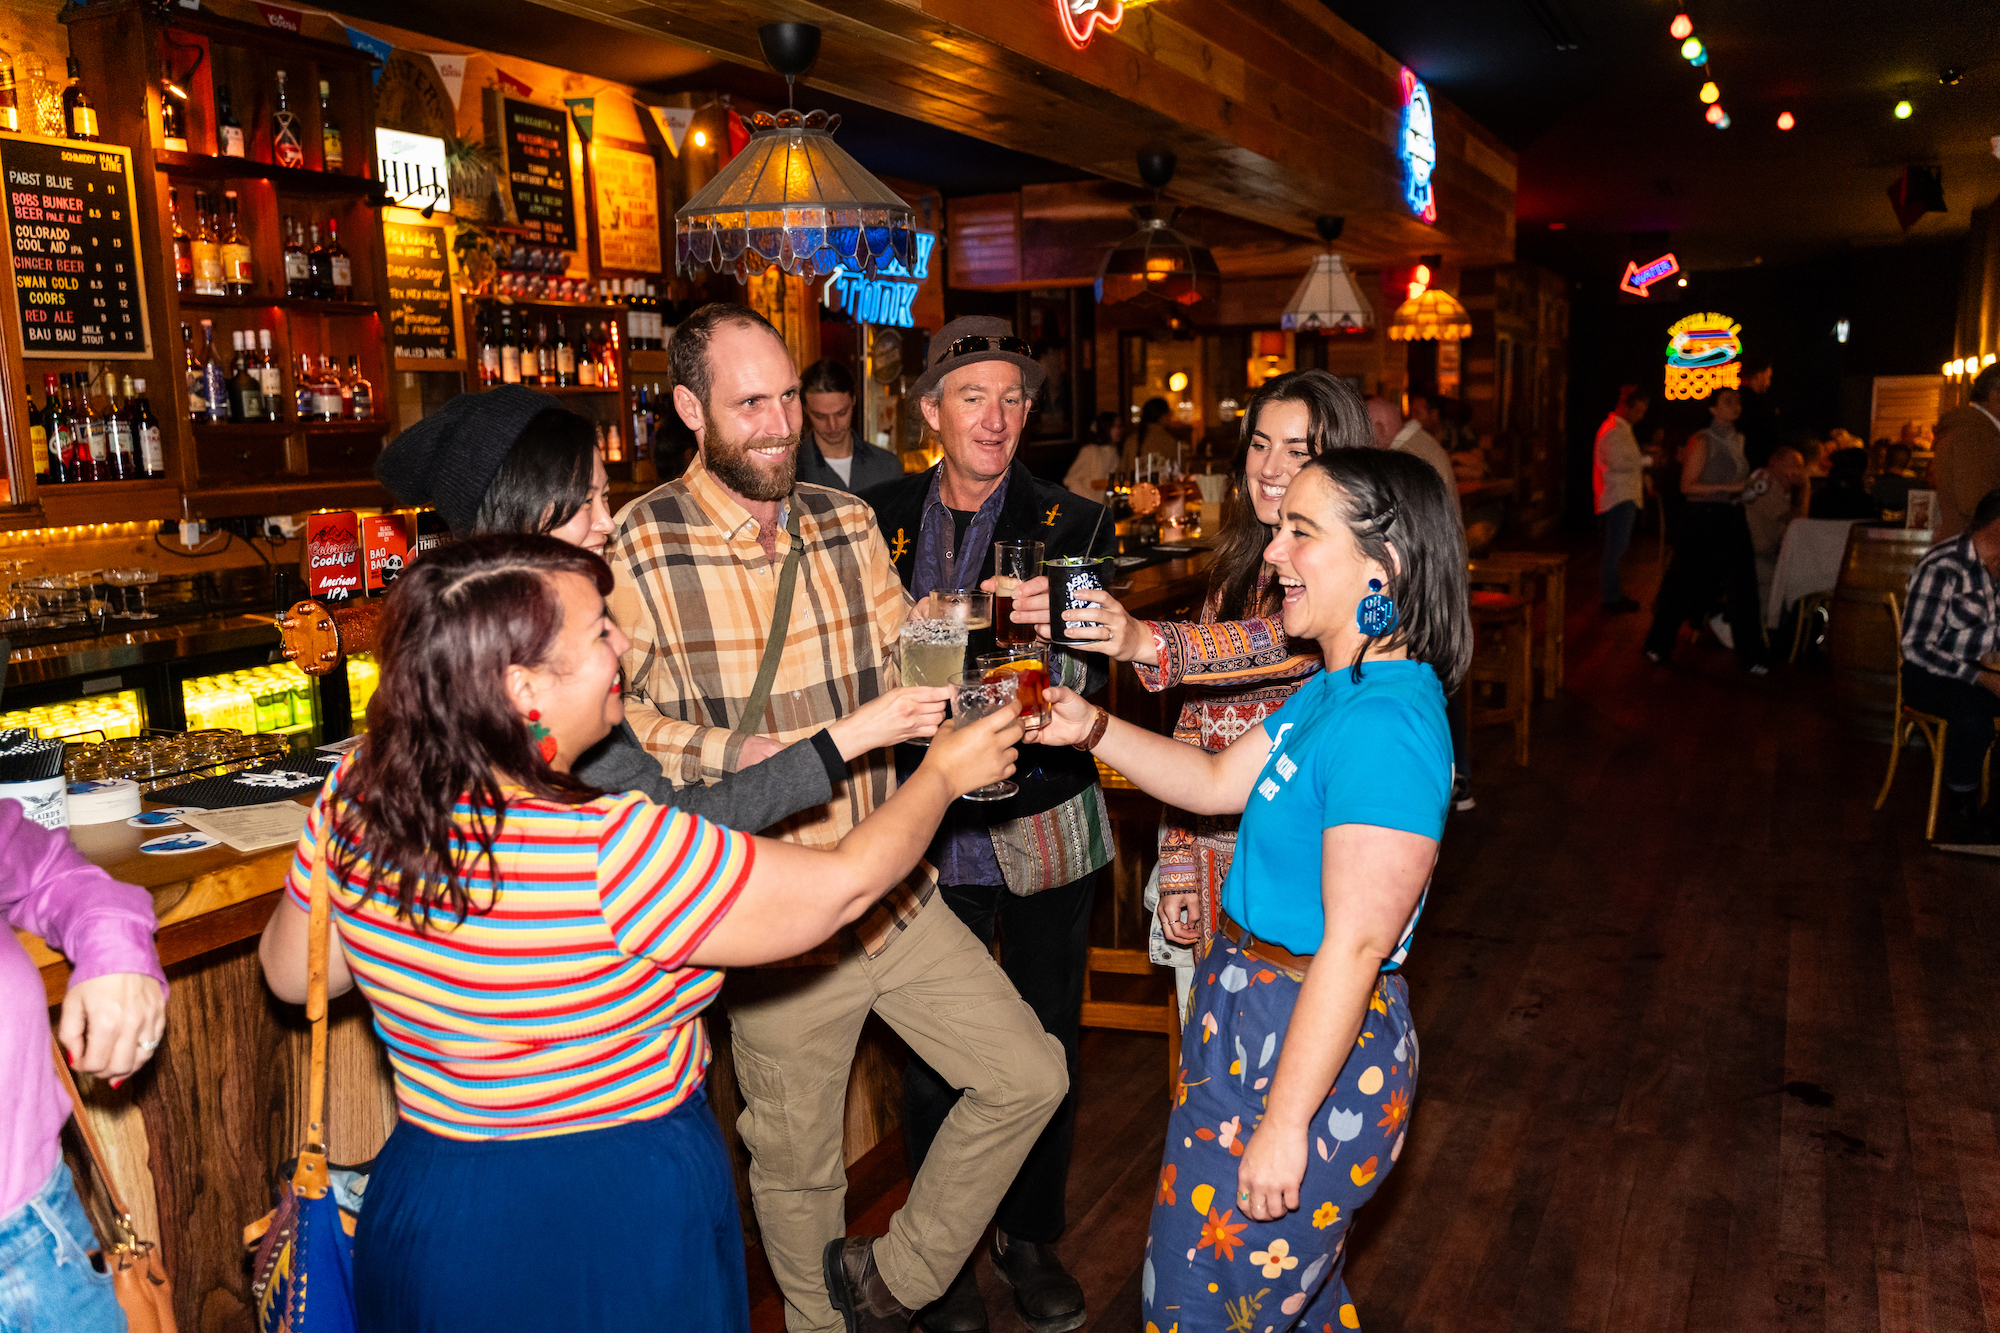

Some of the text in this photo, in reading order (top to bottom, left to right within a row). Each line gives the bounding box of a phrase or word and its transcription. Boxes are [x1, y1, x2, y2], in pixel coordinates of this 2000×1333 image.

[9, 171, 41, 186] PABST
[46, 174, 74, 190] BLUE
[107, 185, 115, 195] 11
[12, 192, 39, 207] BOBS
[43, 195, 83, 211] BUNKER
[112, 210, 120, 220] 12
[15, 206, 82, 224] BEER PALE ALE
[16, 224, 70, 241] COLORADO
[16, 238, 83, 255] COOL AID IPA
[14, 255, 53, 271] GINGER
[56, 259, 85, 273] BEER
[17, 275, 47, 289] SWAN
[118, 281, 127, 291] 12
[29, 291, 66, 306] COORS
[120, 299, 129, 309] 12
[25, 309, 47, 322] RED
[54, 310, 74, 324] ALE
[28, 327, 51, 341] BAU
[55, 328, 76, 341] BAU
[82, 325, 101, 334] MILK
[82, 335, 104, 345] STOUT
[370, 547, 386, 559] BAO
[371, 558, 387, 570] BAO
[319, 575, 357, 588] American
[1066, 572, 1089, 592] DEAD
[327, 587, 349, 600] IPA
